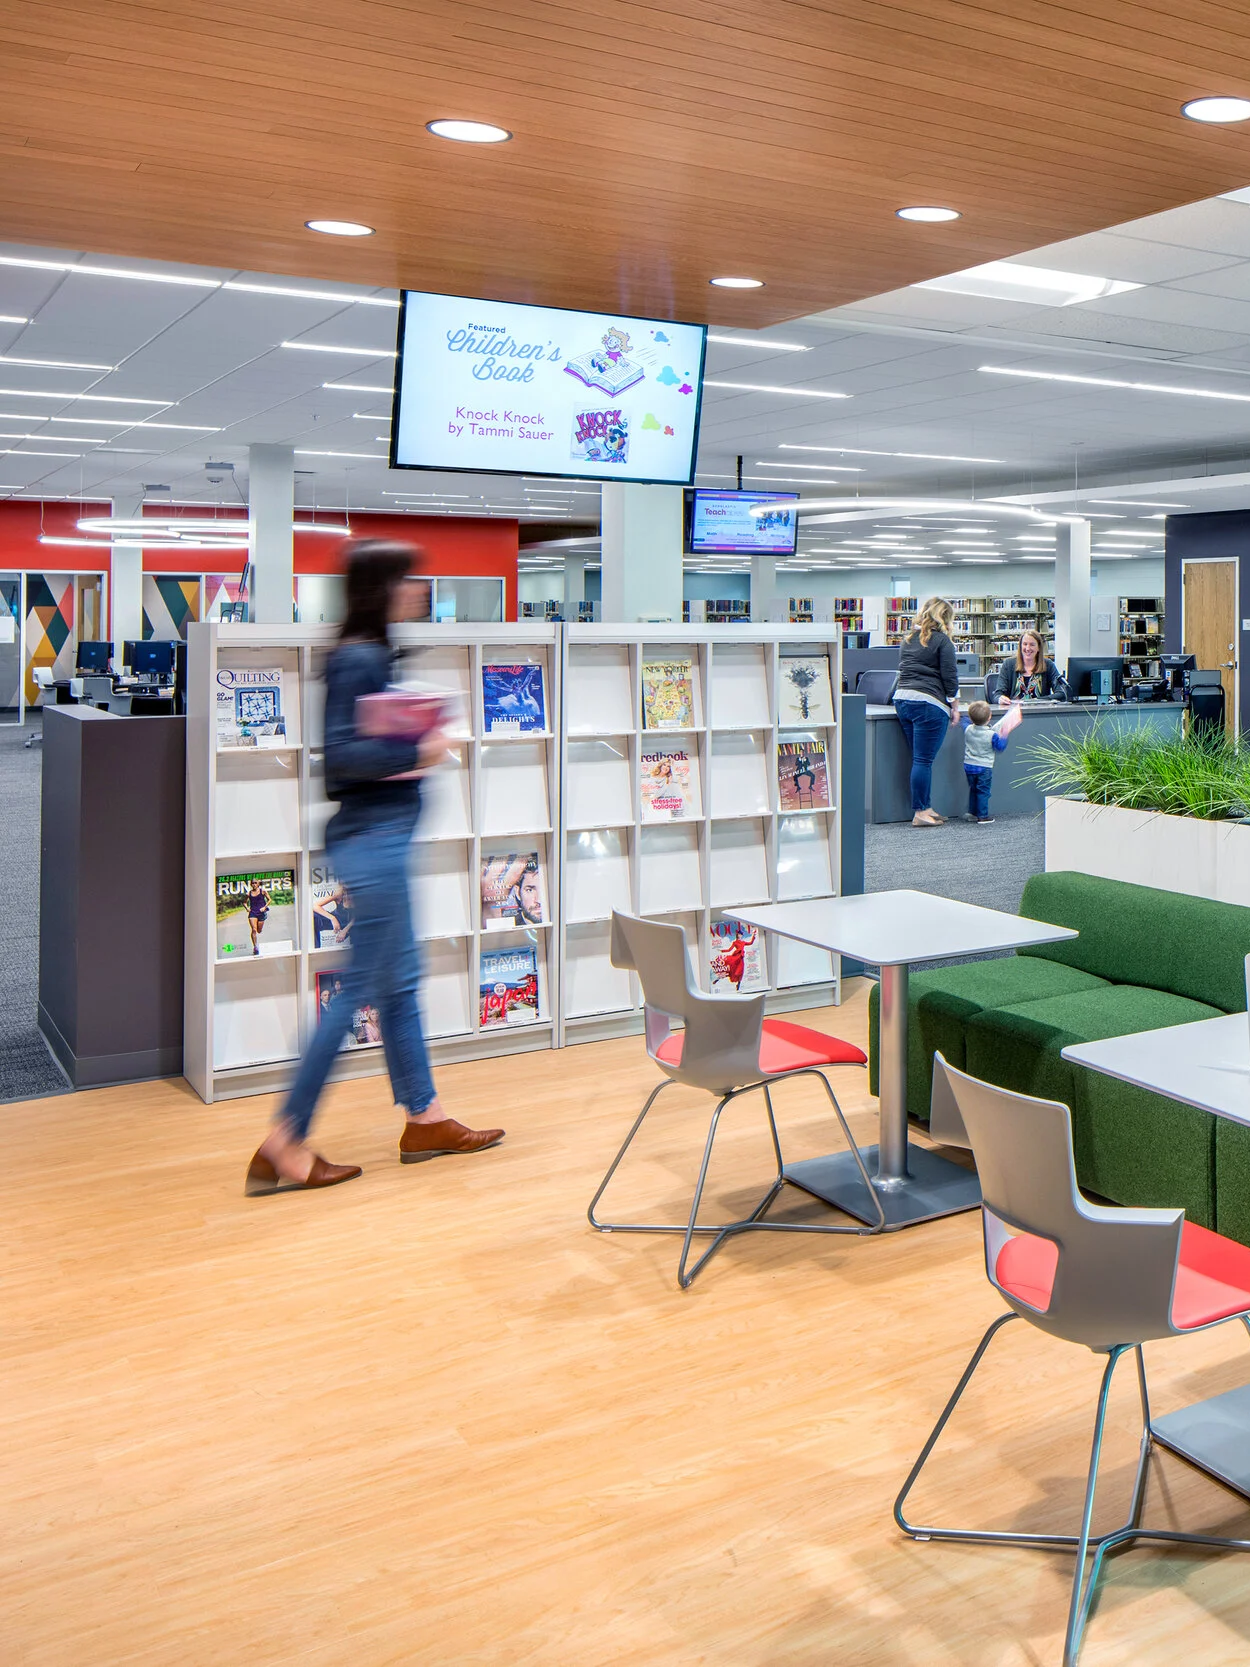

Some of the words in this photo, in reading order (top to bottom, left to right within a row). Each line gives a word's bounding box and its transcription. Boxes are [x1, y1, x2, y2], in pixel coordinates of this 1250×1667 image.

[468, 323, 506, 334] Featured
[447, 329, 562, 361] Children's
[472, 357, 534, 383] Book
[456, 406, 498, 422] Knock
[503, 410, 545, 425] Knock
[576, 410, 622, 431] KNOCK
[448, 421, 464, 437] by
[469, 422, 514, 438] Tammi
[518, 426, 554, 440] Sauer
[575, 425, 608, 443] KNOCK
[646, 665, 661, 673] NEW
[217, 670, 280, 690] QUILTING
[492, 715, 536, 723] DELIGHTS
[641, 751, 689, 763] redbook
[806, 741, 825, 755] FAIR
[218, 877, 292, 896] RUNER'S
[484, 961, 531, 975] LEISURE
[481, 981, 537, 1025] japan
